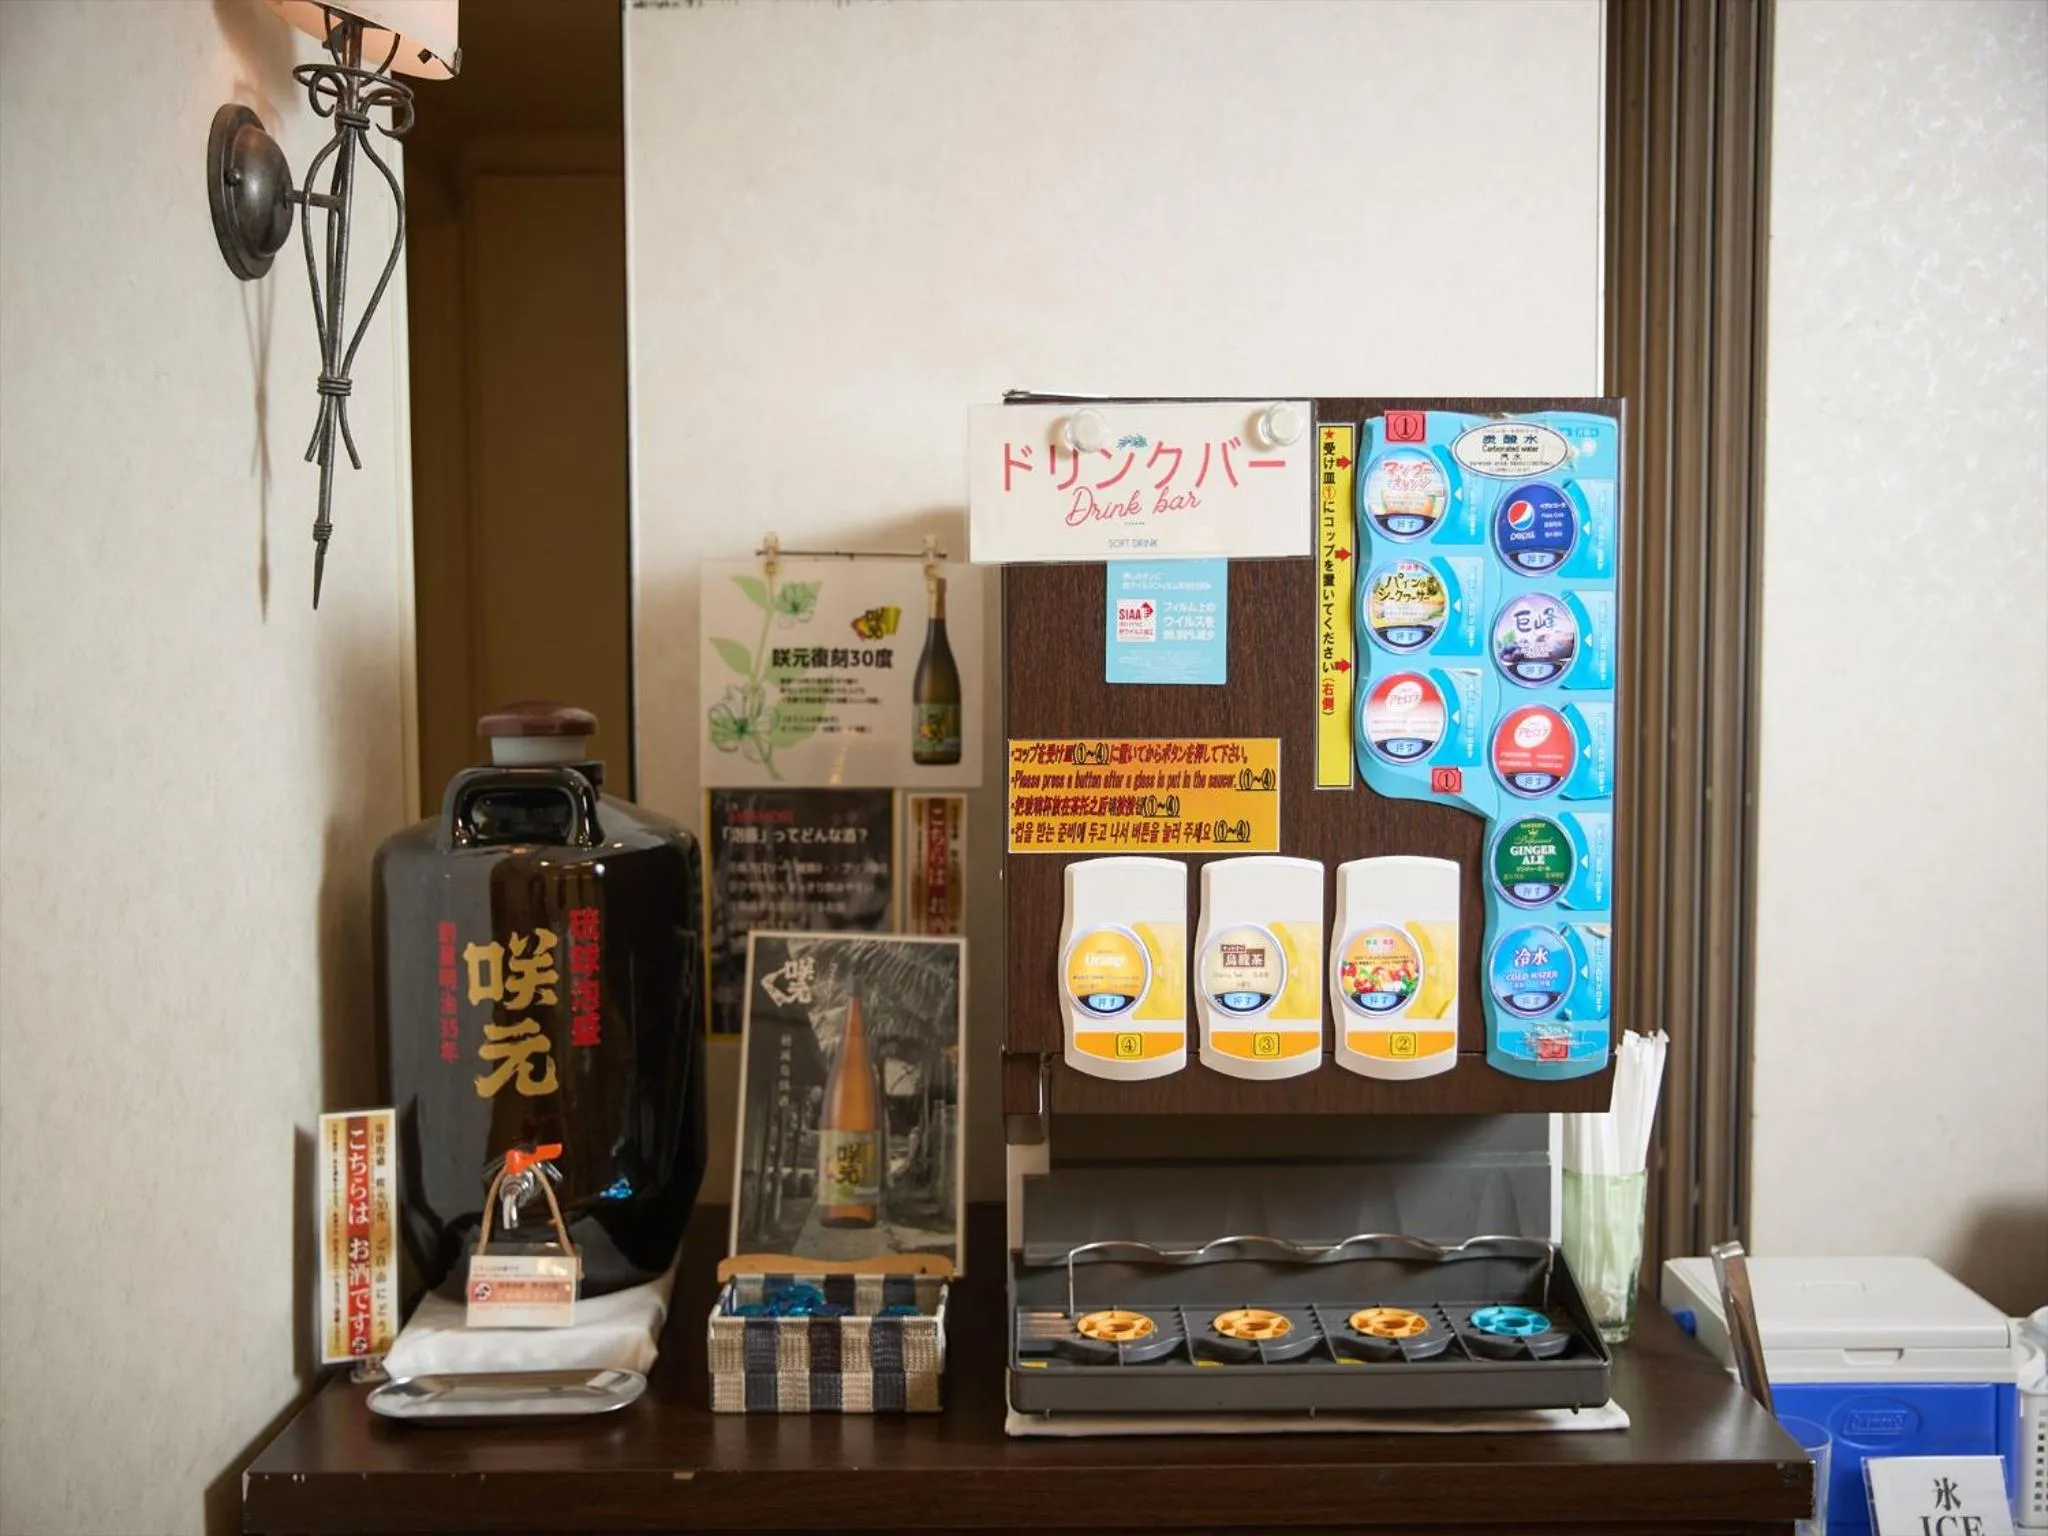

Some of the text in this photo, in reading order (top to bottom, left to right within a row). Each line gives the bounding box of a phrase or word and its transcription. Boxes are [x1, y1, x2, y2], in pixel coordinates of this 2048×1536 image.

[1482, 434, 1538, 445] 炭酸水
[1004, 436, 1285, 491] ドリンクバー
[1065, 486, 1202, 526] Drink bar
[1108, 539, 1159, 548] SOFT DRINK
[1509, 531, 1536, 541] pepsi
[1119, 608, 1142, 620] SIAA
[1014, 770, 1041, 789] Please
[1041, 774, 1065, 790] press
[1075, 770, 1100, 788] button
[1102, 770, 1124, 788] after
[1166, 772, 1181, 790] put
[1193, 770, 1207, 788] the
[1088, 821, 1107, 844] 두고
[1183, 821, 1212, 844] 주세요
[1509, 845, 1557, 856] GINGER
[1521, 855, 1546, 865] ALE
[1514, 946, 1549, 967] 冷水
[462, 927, 560, 1098] 咲元
[348, 1128, 371, 1335] こちらは お酒です
[1933, 1476, 1962, 1511] 氷
[1919, 1515, 1985, 1536] ICE
